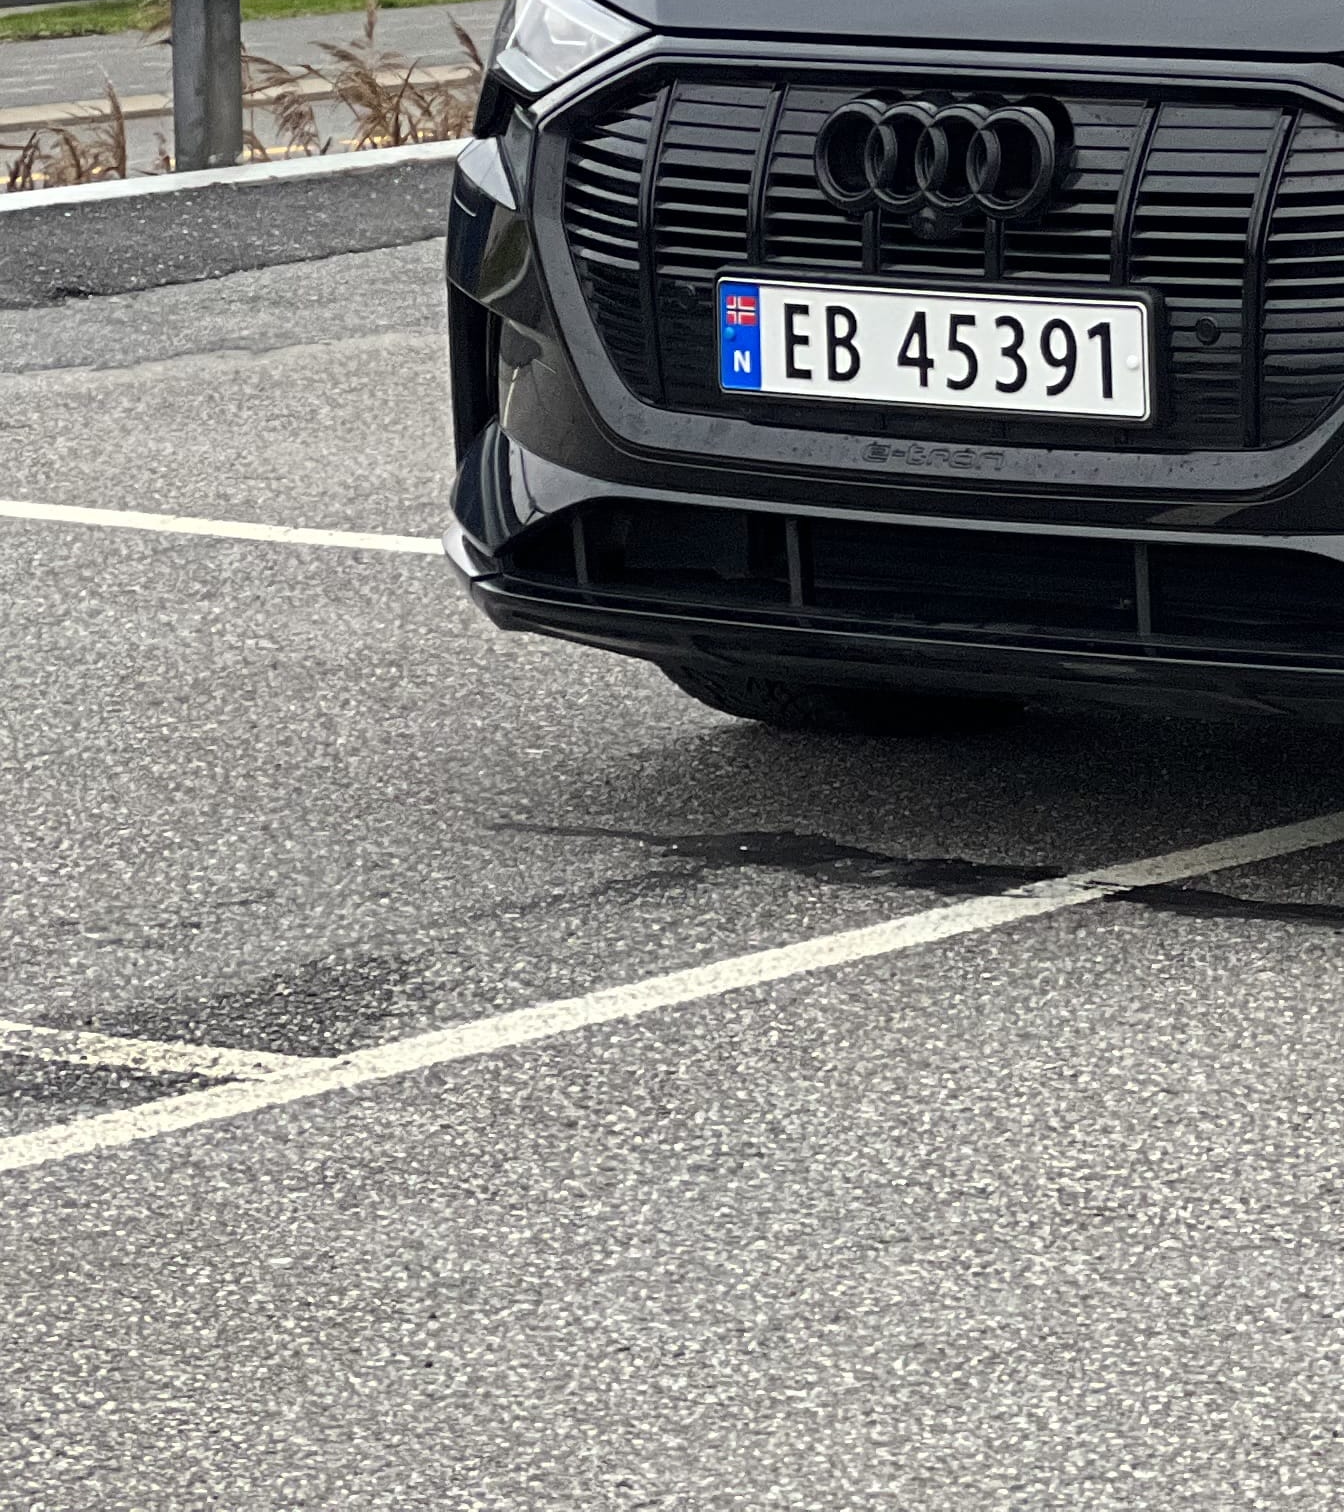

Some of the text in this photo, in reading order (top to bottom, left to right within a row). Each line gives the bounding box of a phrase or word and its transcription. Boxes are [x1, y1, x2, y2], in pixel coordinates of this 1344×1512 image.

[733, 350, 751, 374] N
[783, 302, 1113, 399] EB 45391
[860, 439, 1006, 471] e-tron
